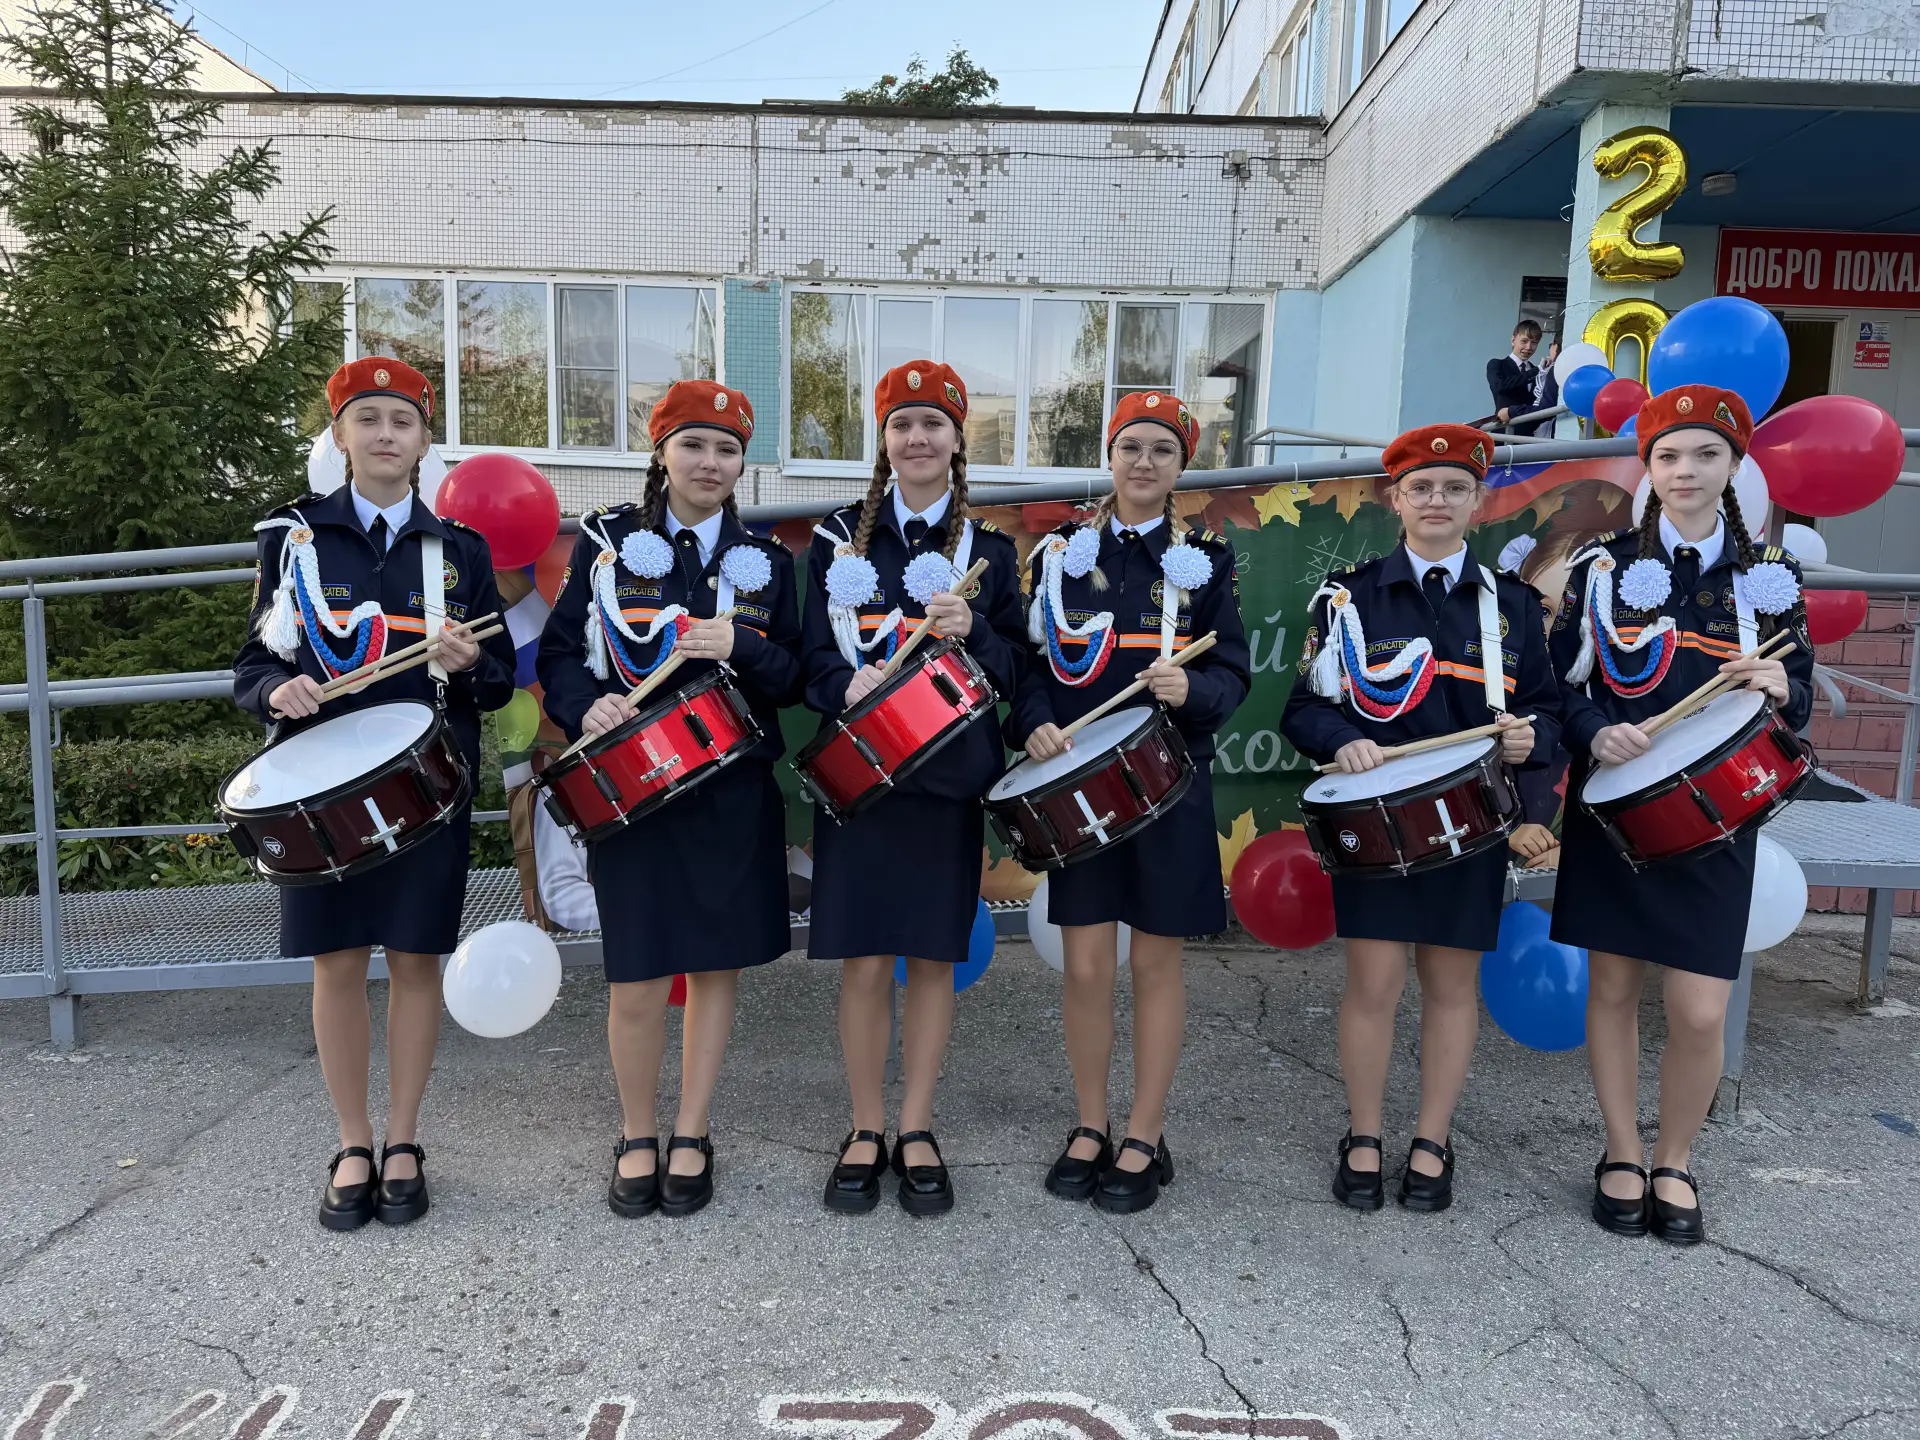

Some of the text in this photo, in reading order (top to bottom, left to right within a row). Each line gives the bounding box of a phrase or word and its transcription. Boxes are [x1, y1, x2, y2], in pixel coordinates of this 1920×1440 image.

[1588, 125, 1689, 282] 2
[1726, 246, 1920, 294] ДОБРО ПОЖА
[1068, 611, 1095, 622] СПАСАТЕ
[1374, 640, 1409, 653] СПАСАТЕЛ
